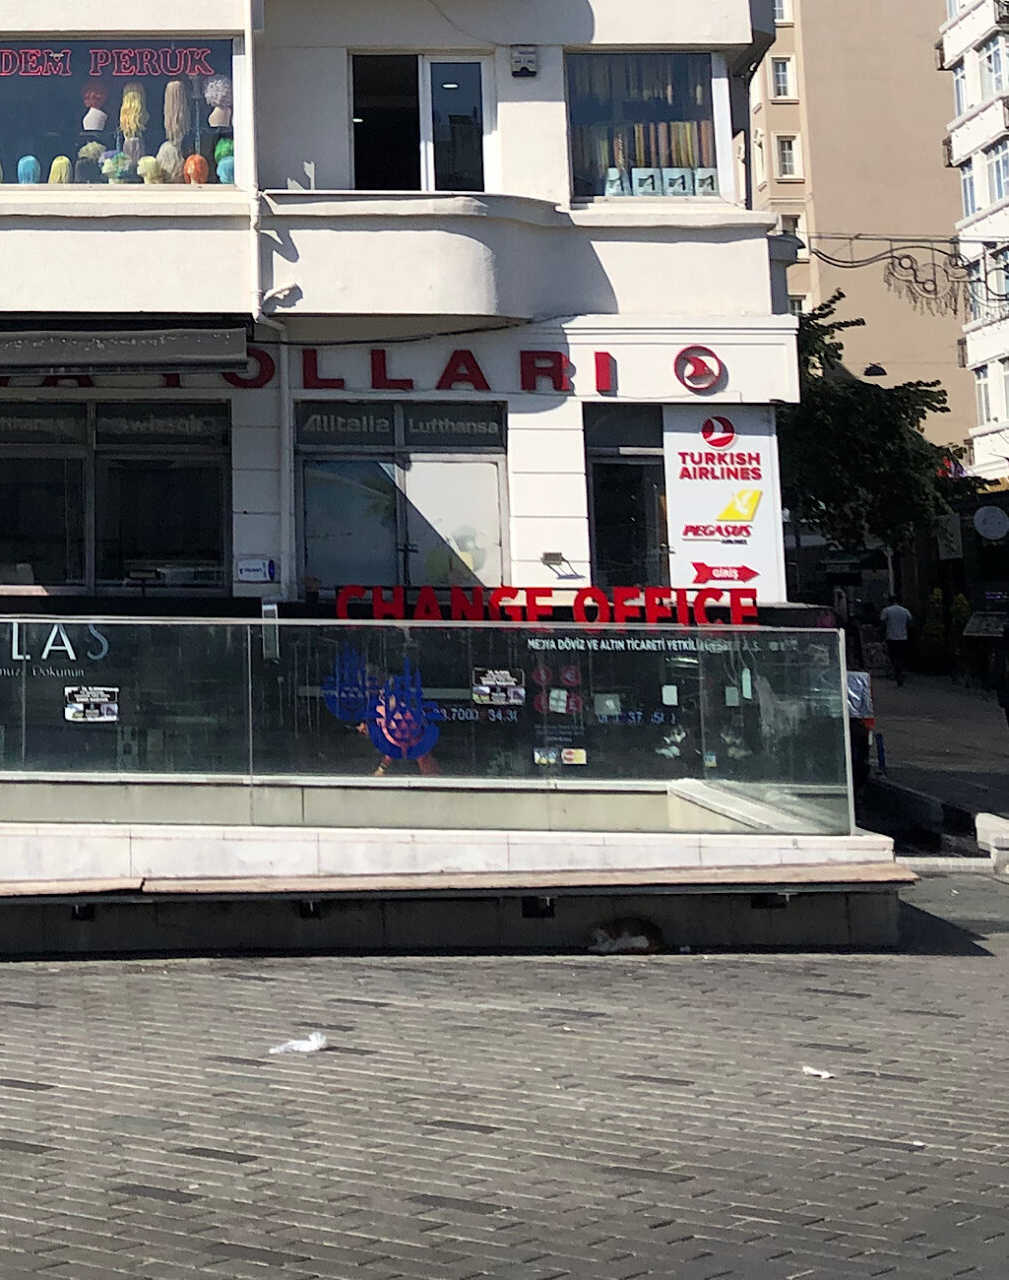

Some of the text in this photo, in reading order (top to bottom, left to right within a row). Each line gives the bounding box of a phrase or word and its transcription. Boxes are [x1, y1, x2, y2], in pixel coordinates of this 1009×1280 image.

[89, 48, 215, 76] PERUK
[165, 348, 614, 392] OLLARI
[302, 413, 391, 433] Alitalia
[409, 417, 500, 436] Lufthansa
[678, 451, 761, 466] TURKISH
[679, 466, 763, 481] AIRLINES
[682, 523, 754, 538] PEGASUS
[336, 584, 759, 634] CHANGE OFFICE
